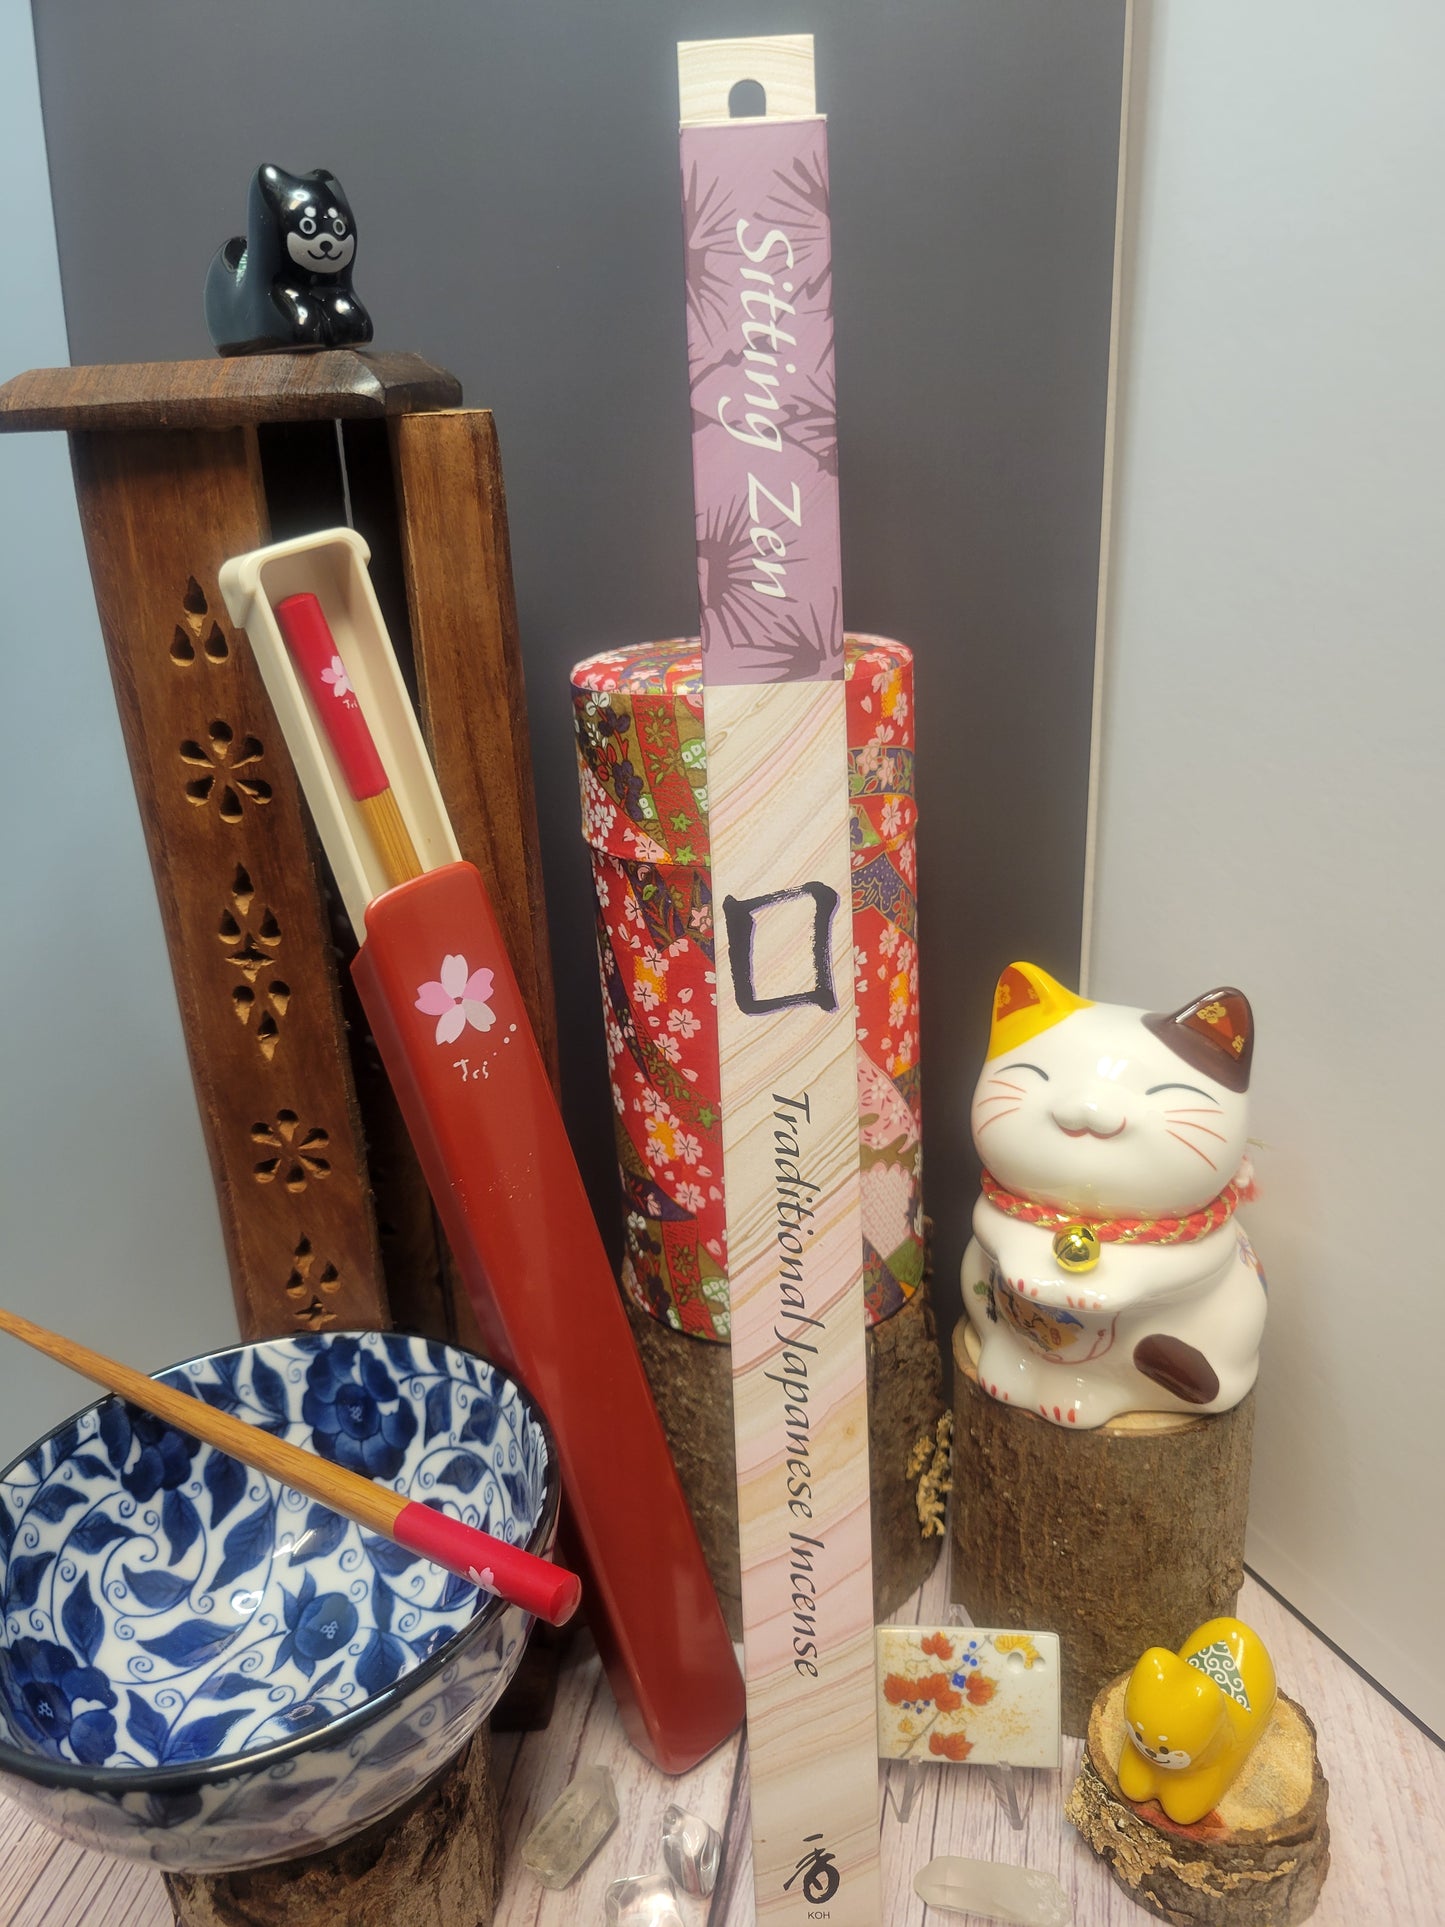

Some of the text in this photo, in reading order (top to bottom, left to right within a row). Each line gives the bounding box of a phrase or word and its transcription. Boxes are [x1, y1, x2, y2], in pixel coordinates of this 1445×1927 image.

[717, 218, 802, 598] Sitting Zen
[763, 1091, 826, 1678] Traditional Japanese Incense
[807, 1911, 831, 1920] KOH
